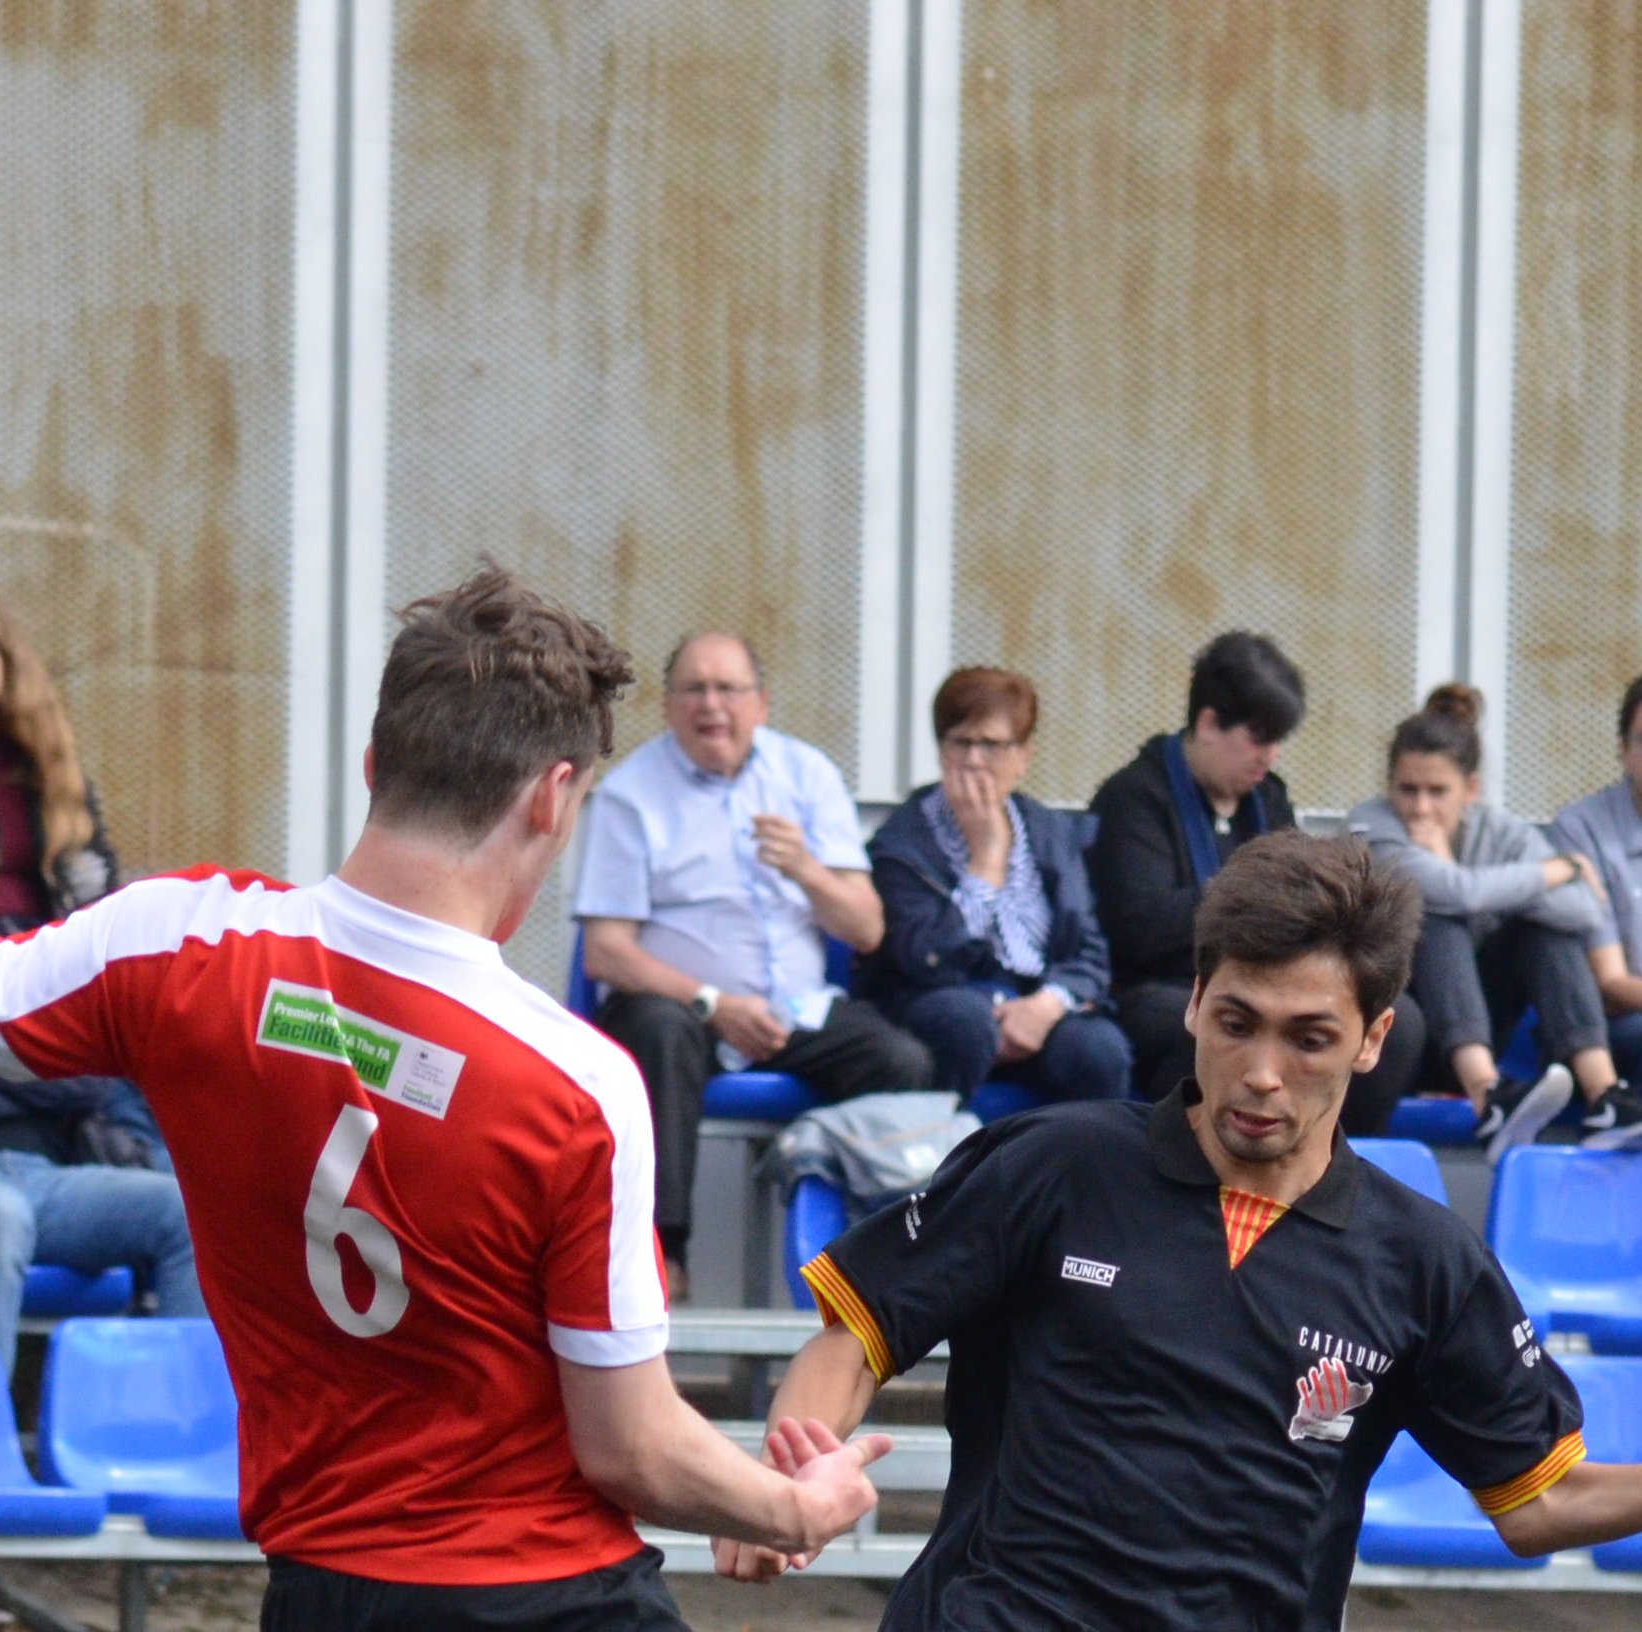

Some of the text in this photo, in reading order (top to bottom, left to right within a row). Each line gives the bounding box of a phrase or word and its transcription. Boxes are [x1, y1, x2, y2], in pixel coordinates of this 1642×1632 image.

[273, 1002, 320, 1023] Premier
[268, 1015, 342, 1049] Facilitie
[304, 1103, 410, 1339] 6
[1063, 1259, 1115, 1284] MUNICH
